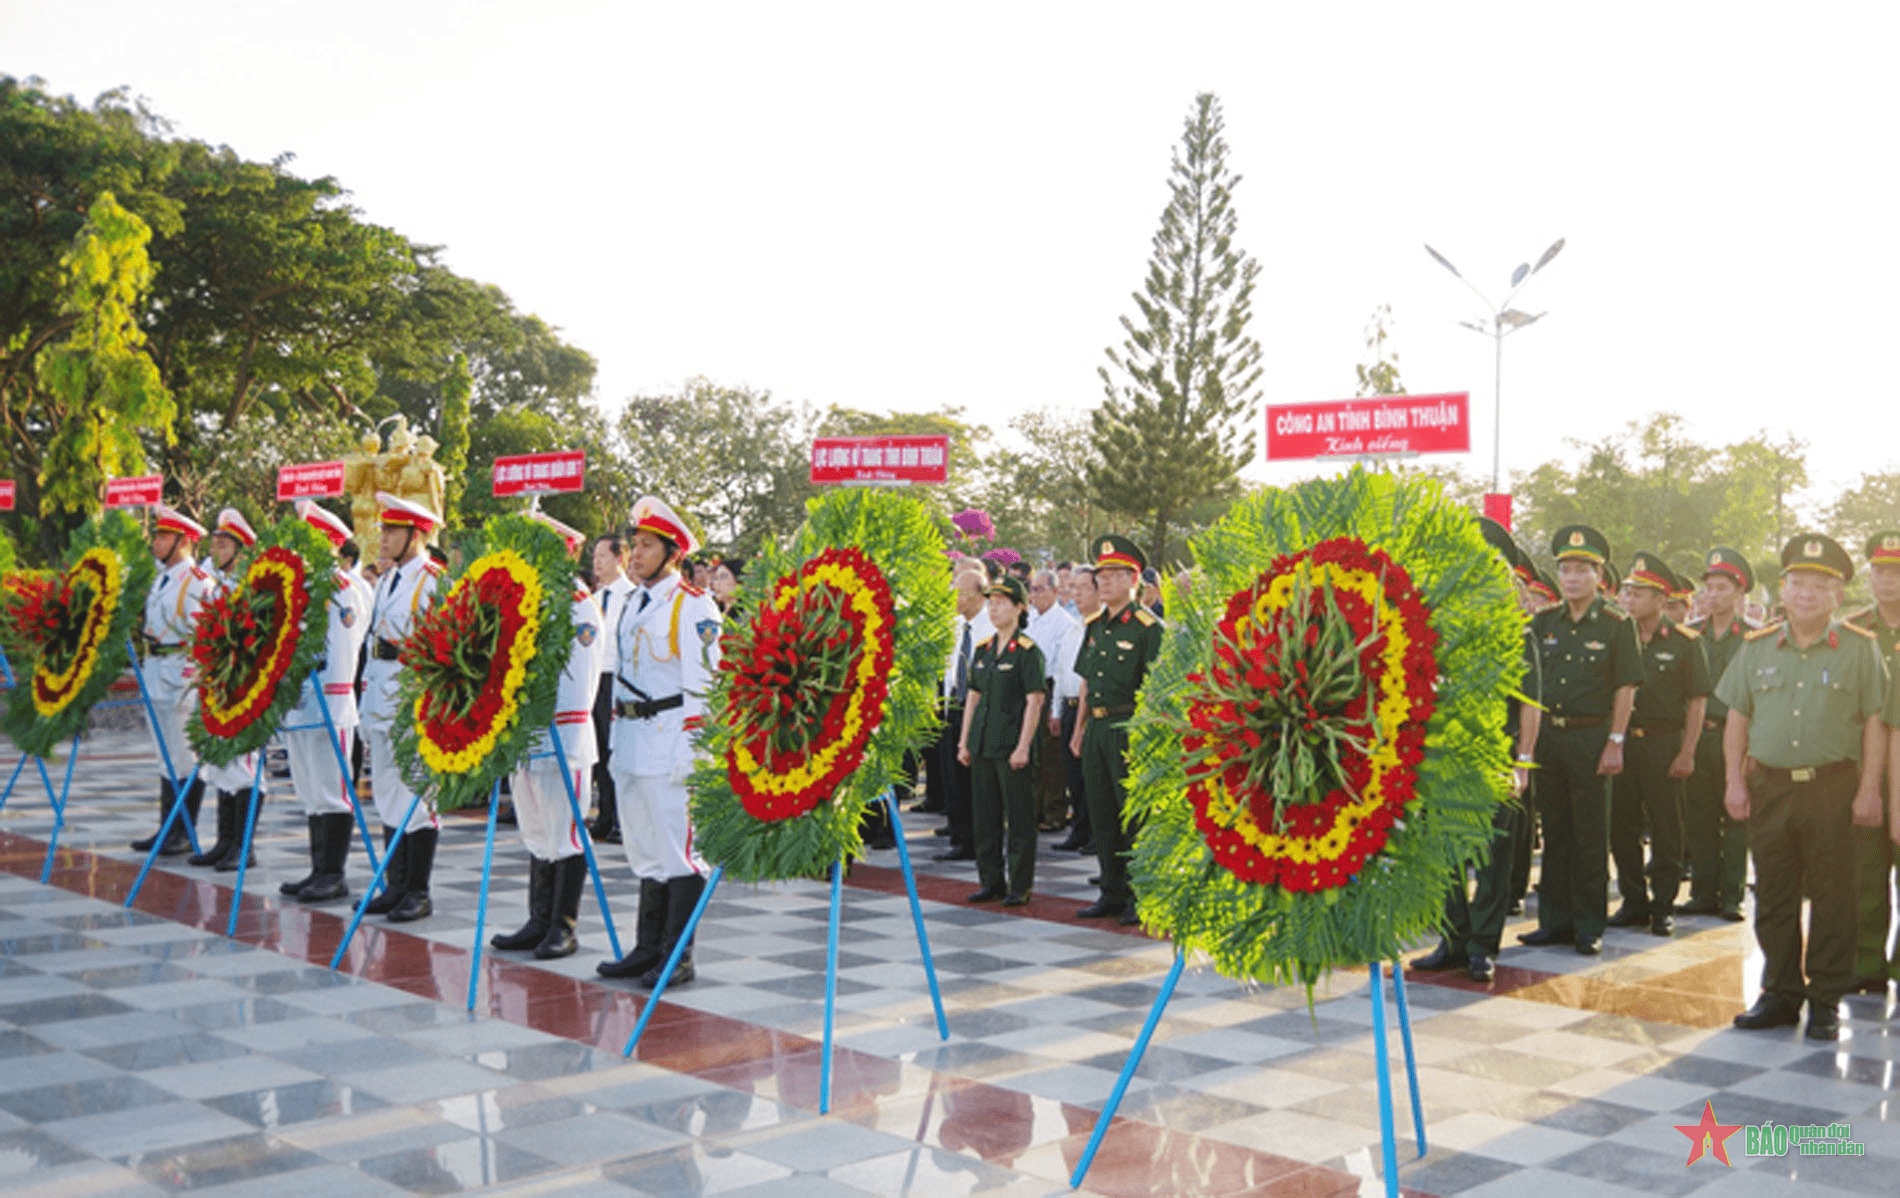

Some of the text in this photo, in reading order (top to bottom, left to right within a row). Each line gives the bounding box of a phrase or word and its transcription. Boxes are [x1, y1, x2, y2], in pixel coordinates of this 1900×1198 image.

[1276, 400, 1458, 435] CÔNG AN TỈNH BÌNH THUẬN
